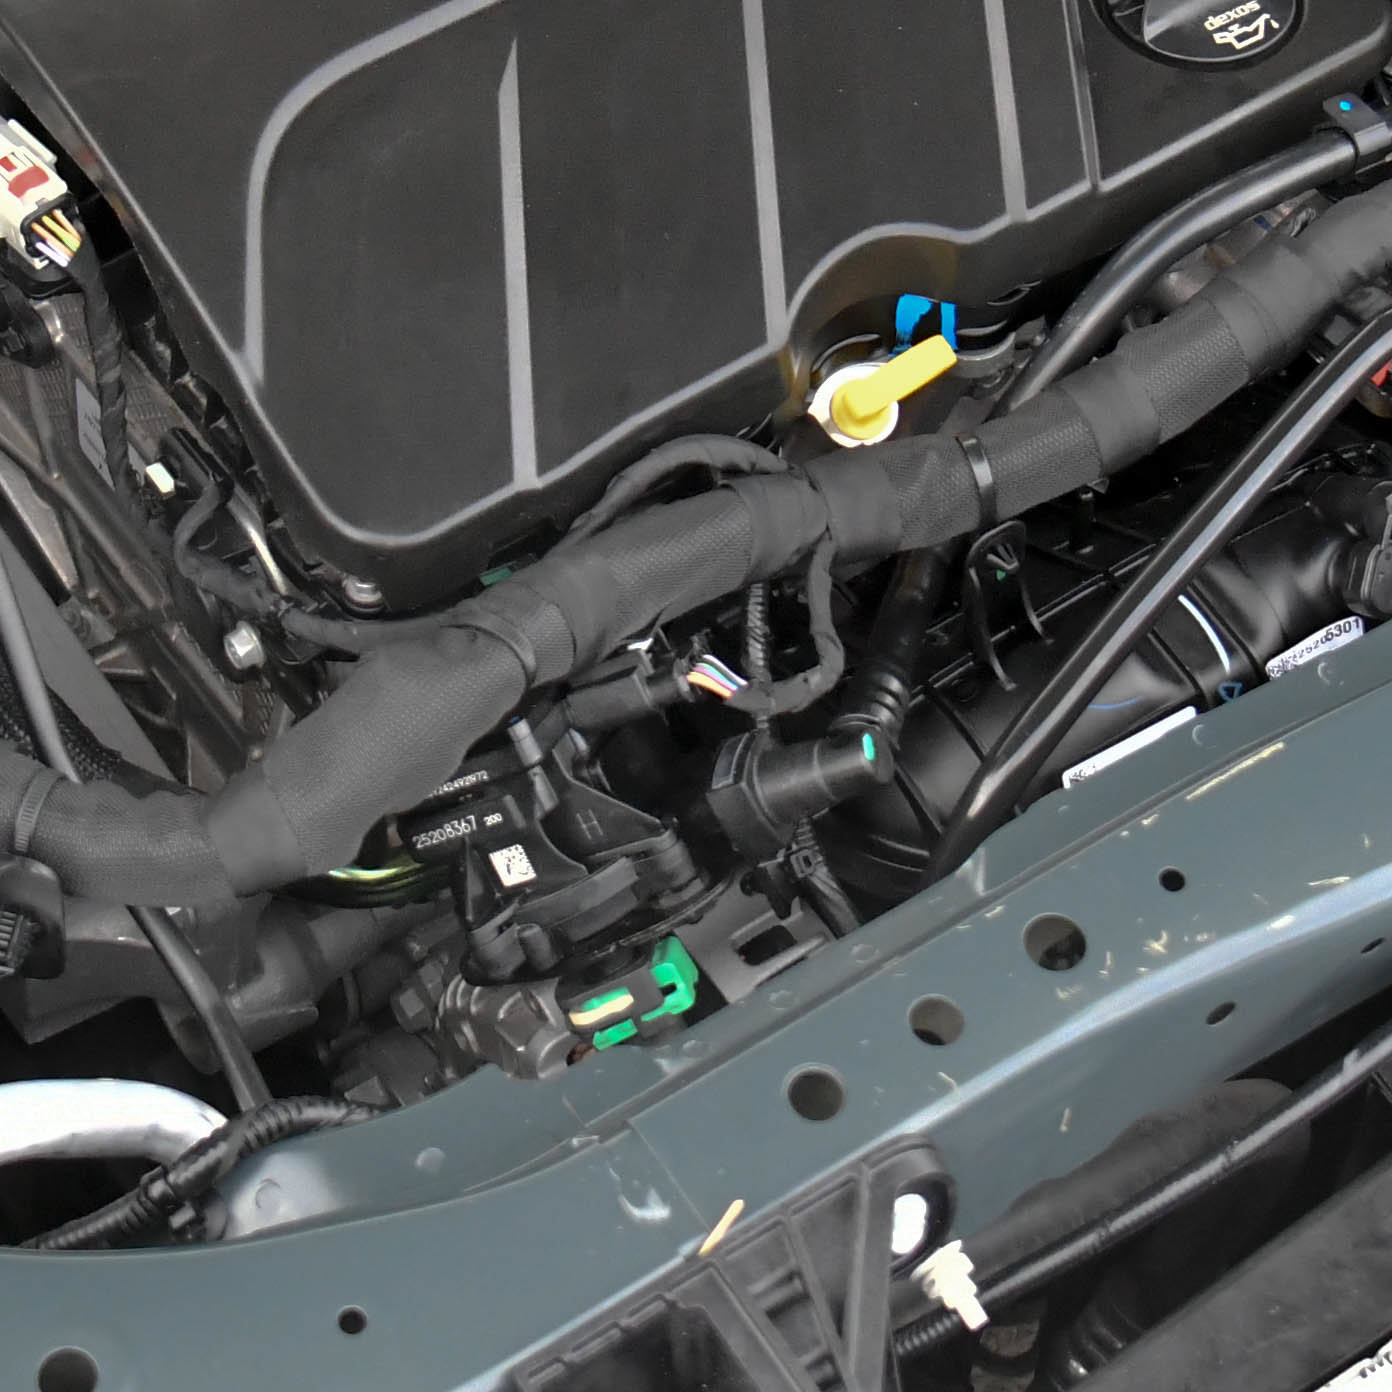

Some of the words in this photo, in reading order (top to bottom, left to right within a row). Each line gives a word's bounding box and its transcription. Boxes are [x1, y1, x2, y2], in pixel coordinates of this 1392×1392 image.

[1203, 0, 1260, 31] dexos
[412, 814, 477, 849] 25208367
[483, 812, 503, 826] 200
